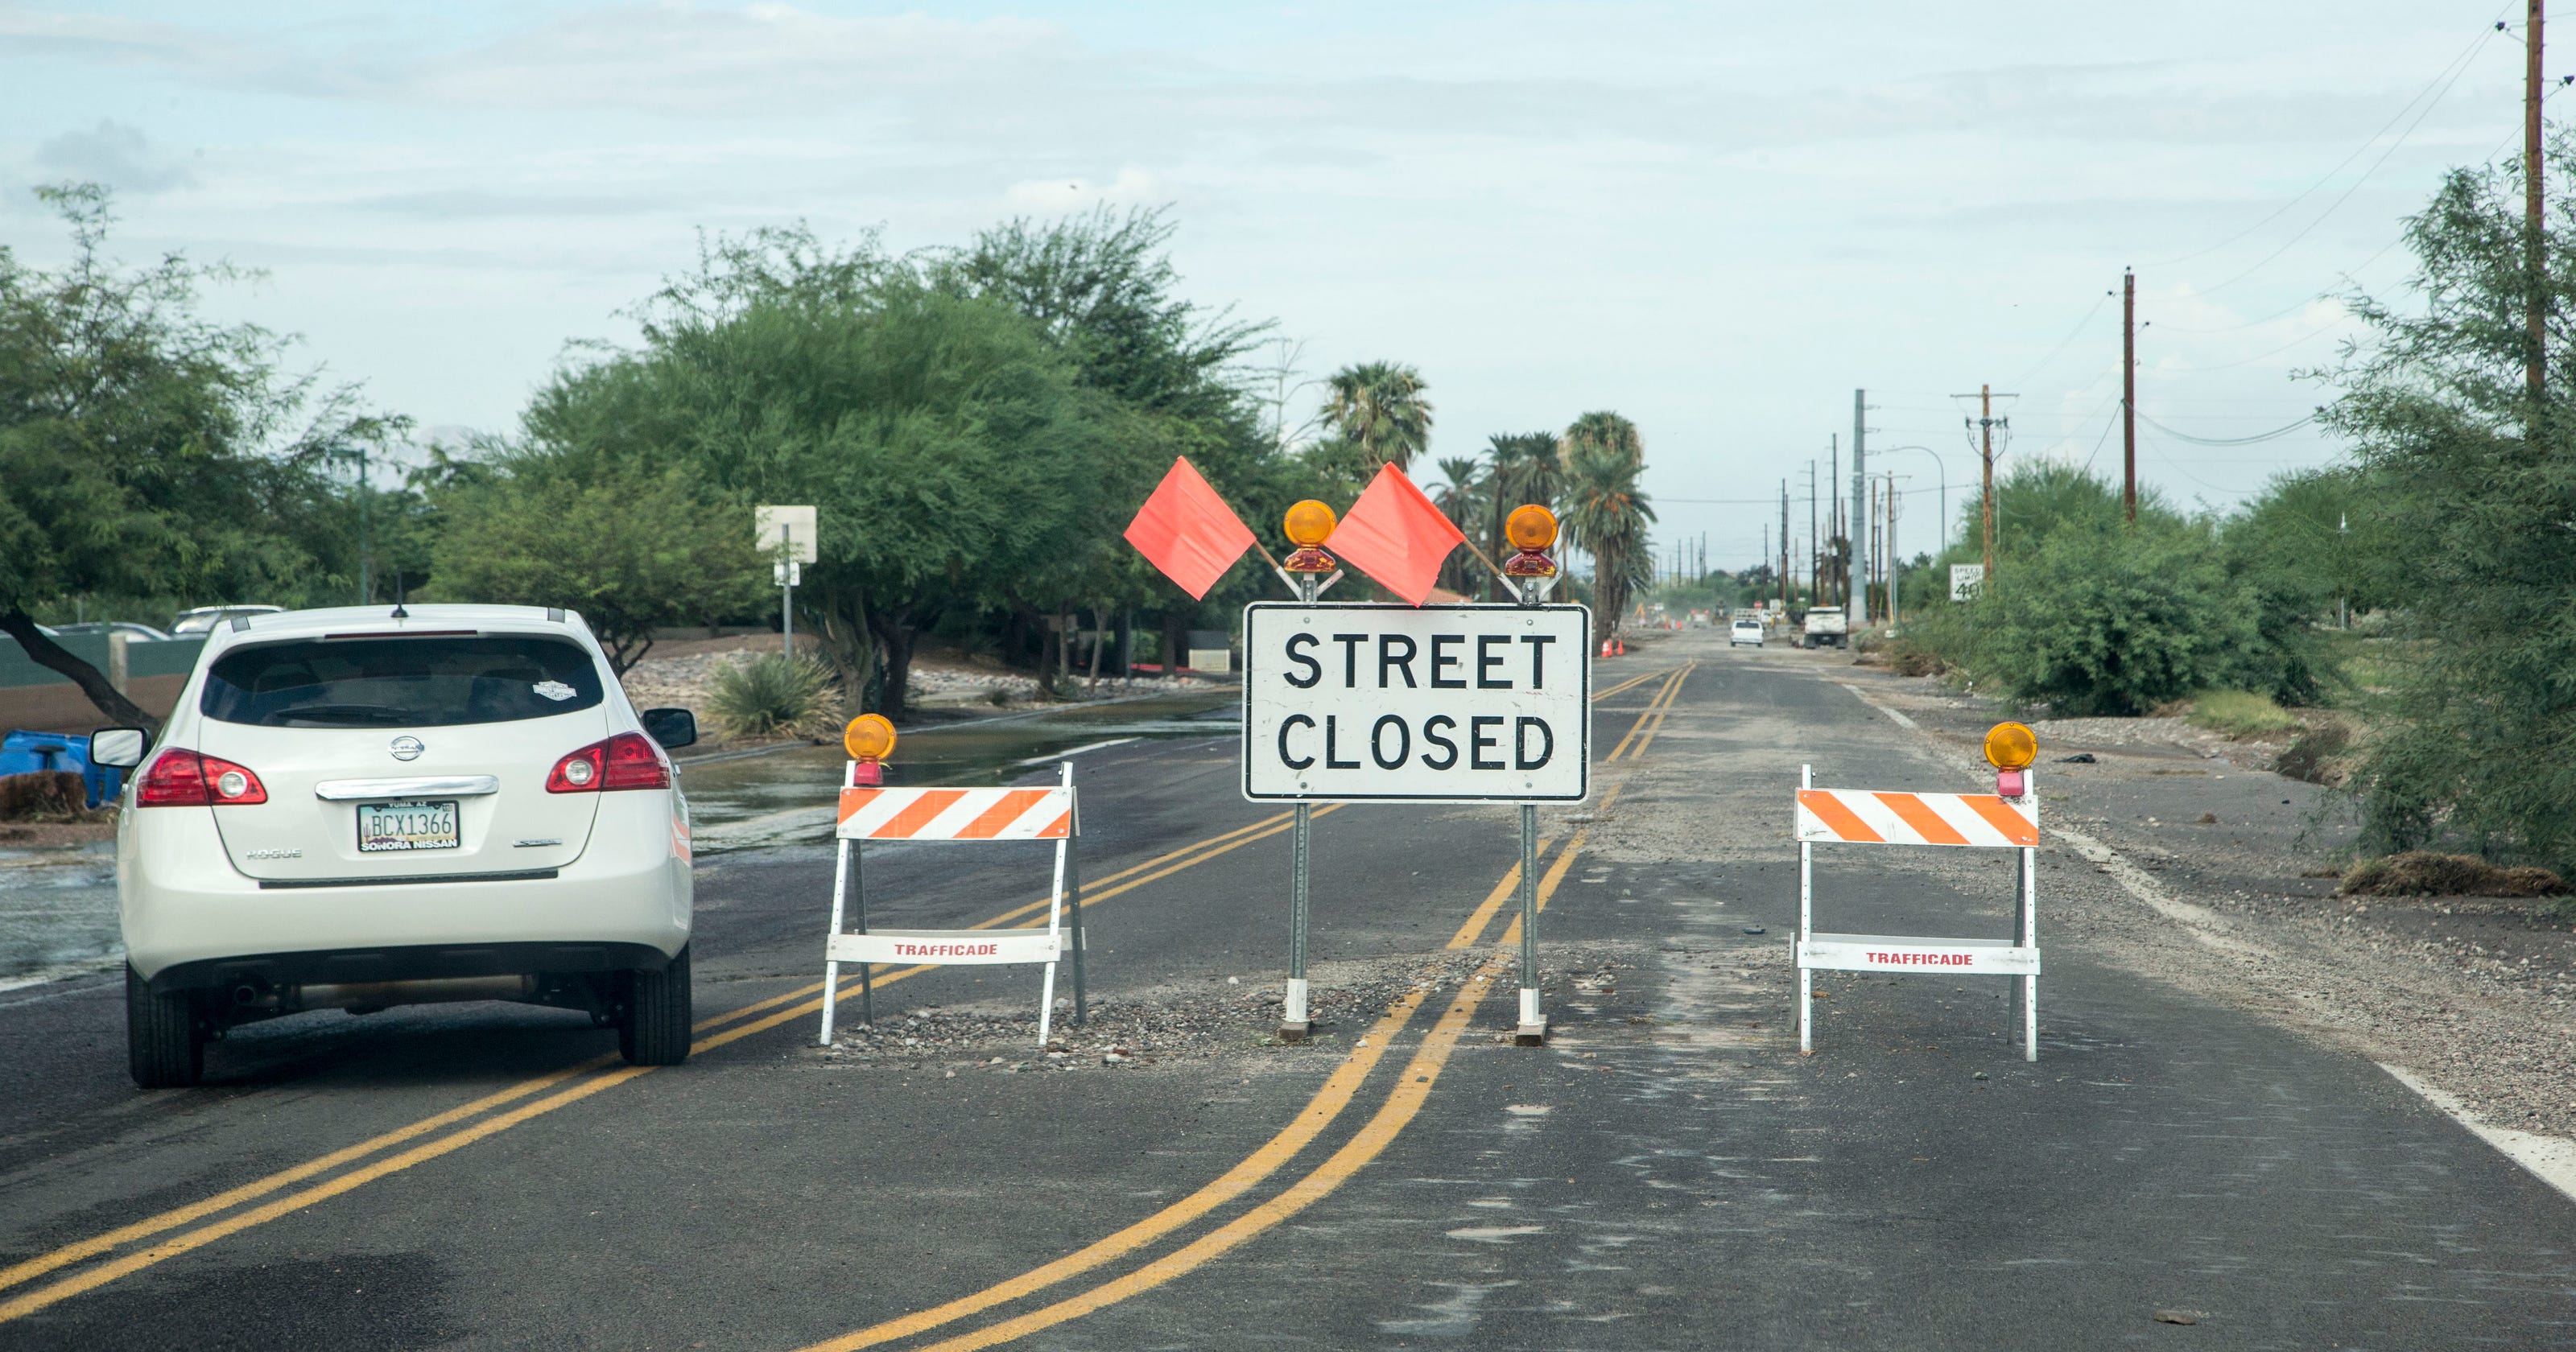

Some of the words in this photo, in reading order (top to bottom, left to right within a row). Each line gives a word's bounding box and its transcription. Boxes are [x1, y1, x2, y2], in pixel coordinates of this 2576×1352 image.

[1955, 583, 1980, 598] 40
[1283, 633, 1556, 689] STREET
[1278, 714, 1554, 771] CLOSED
[372, 813, 452, 836] BCX1366
[361, 842, 411, 851] SONORA
[413, 839, 457, 849] NISSAN
[246, 849, 302, 859] ROGUE
[894, 944, 997, 956] TRAFFICADE
[1866, 952, 1973, 966] TRAFFICADE
